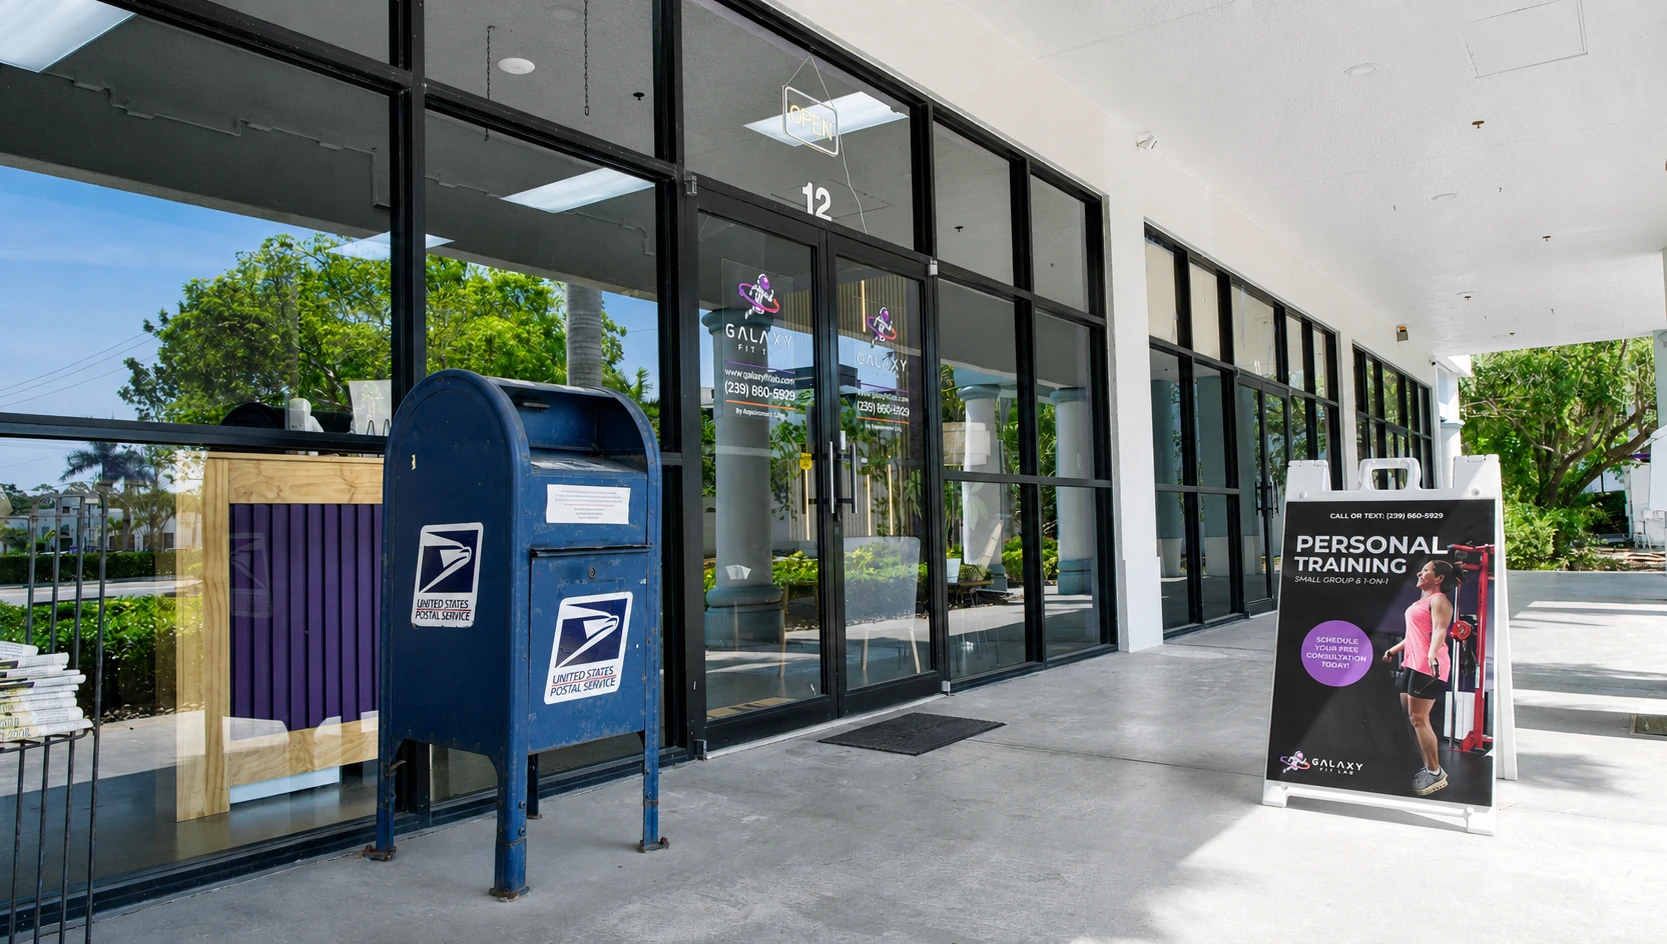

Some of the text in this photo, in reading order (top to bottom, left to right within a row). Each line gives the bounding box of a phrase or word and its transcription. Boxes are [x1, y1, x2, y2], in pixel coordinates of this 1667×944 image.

[789, 104, 833, 141] OPEN
[802, 182, 833, 222] 12
[725, 323, 792, 349] GALAXY
[738, 343, 755, 353] FIT
[724, 380, 749, 398] (239)
[1386, 512, 1405, 520] (239)
[1296, 535, 1449, 555] PERSONAL
[1294, 556, 1407, 574] TRAINING
[417, 599, 469, 609] UNITED STATES
[415, 611, 471, 621] POSTAL SERVICE
[1315, 636, 1359, 645] SCHEDULE
[552, 666, 614, 684] UNITED STATES
[550, 677, 616, 697] POSTAL SERVICE
[1312, 758, 1363, 771] GALAXY
